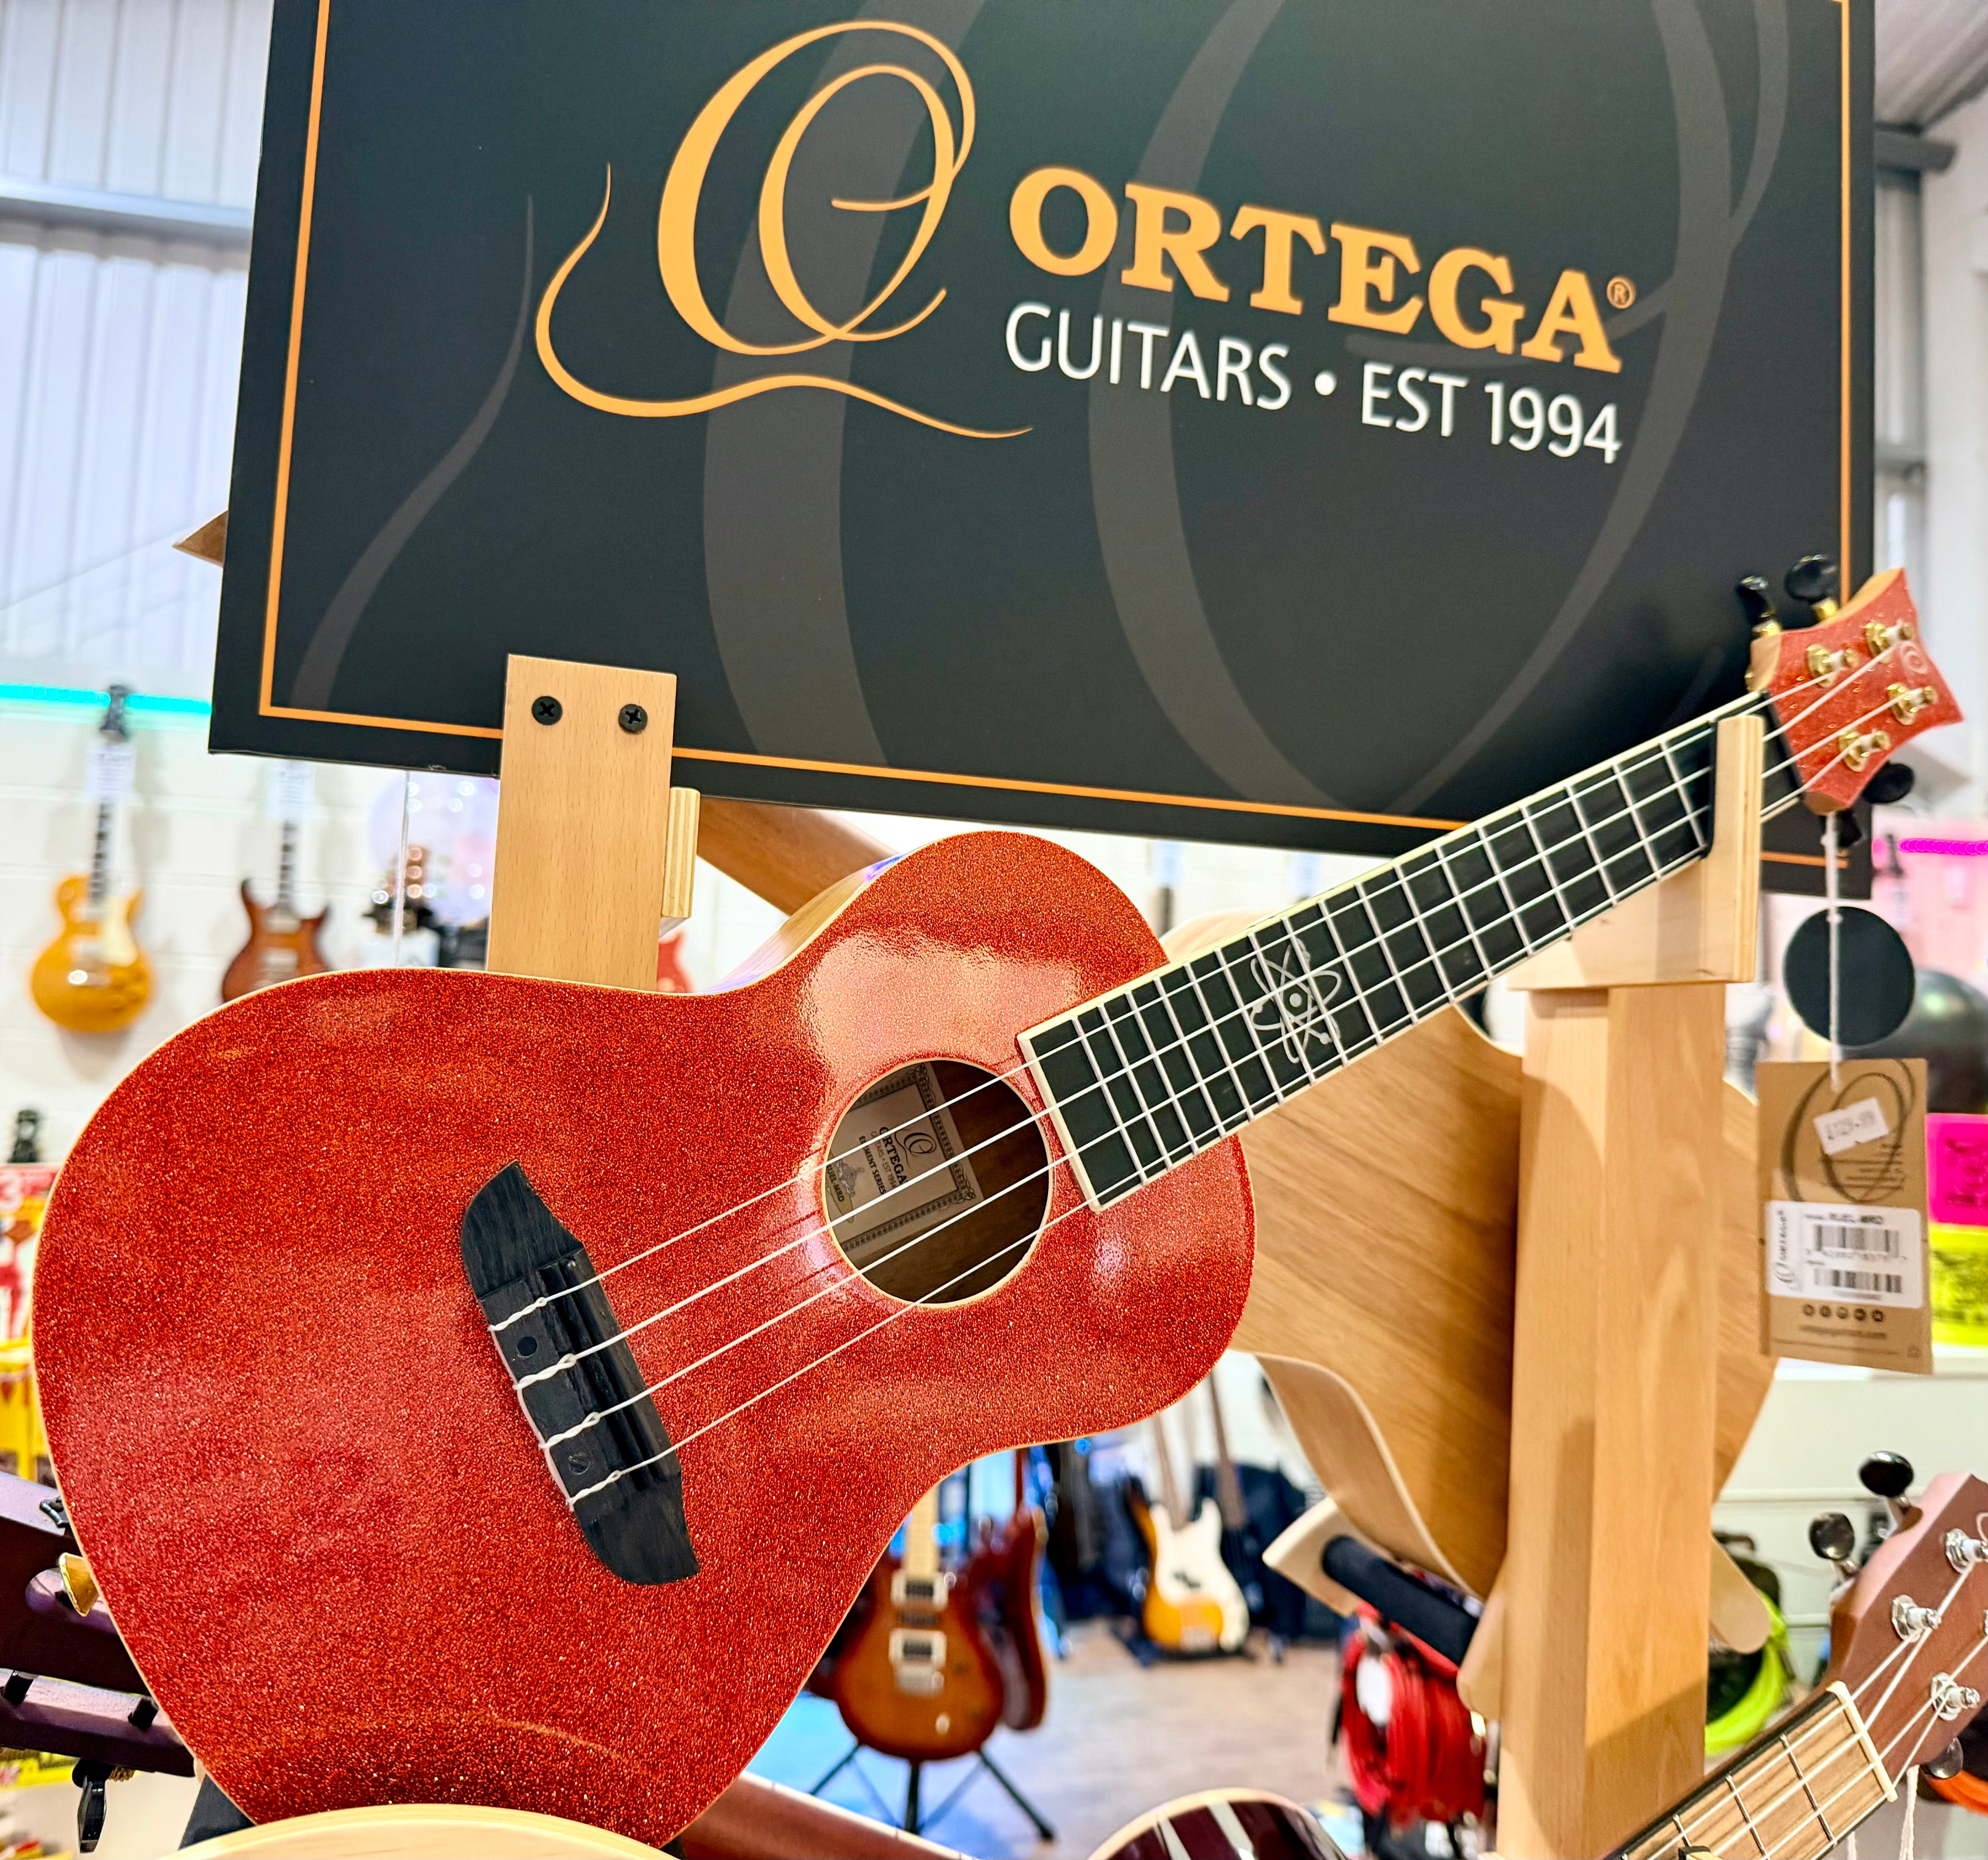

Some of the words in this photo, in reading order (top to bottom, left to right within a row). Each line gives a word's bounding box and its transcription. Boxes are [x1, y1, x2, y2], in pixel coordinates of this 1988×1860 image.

[1005, 301, 1292, 410] GUITARS
[1361, 361, 1468, 437] EST
[1484, 382, 1622, 464] 1994
[872, 1169, 887, 1195] SERIES
